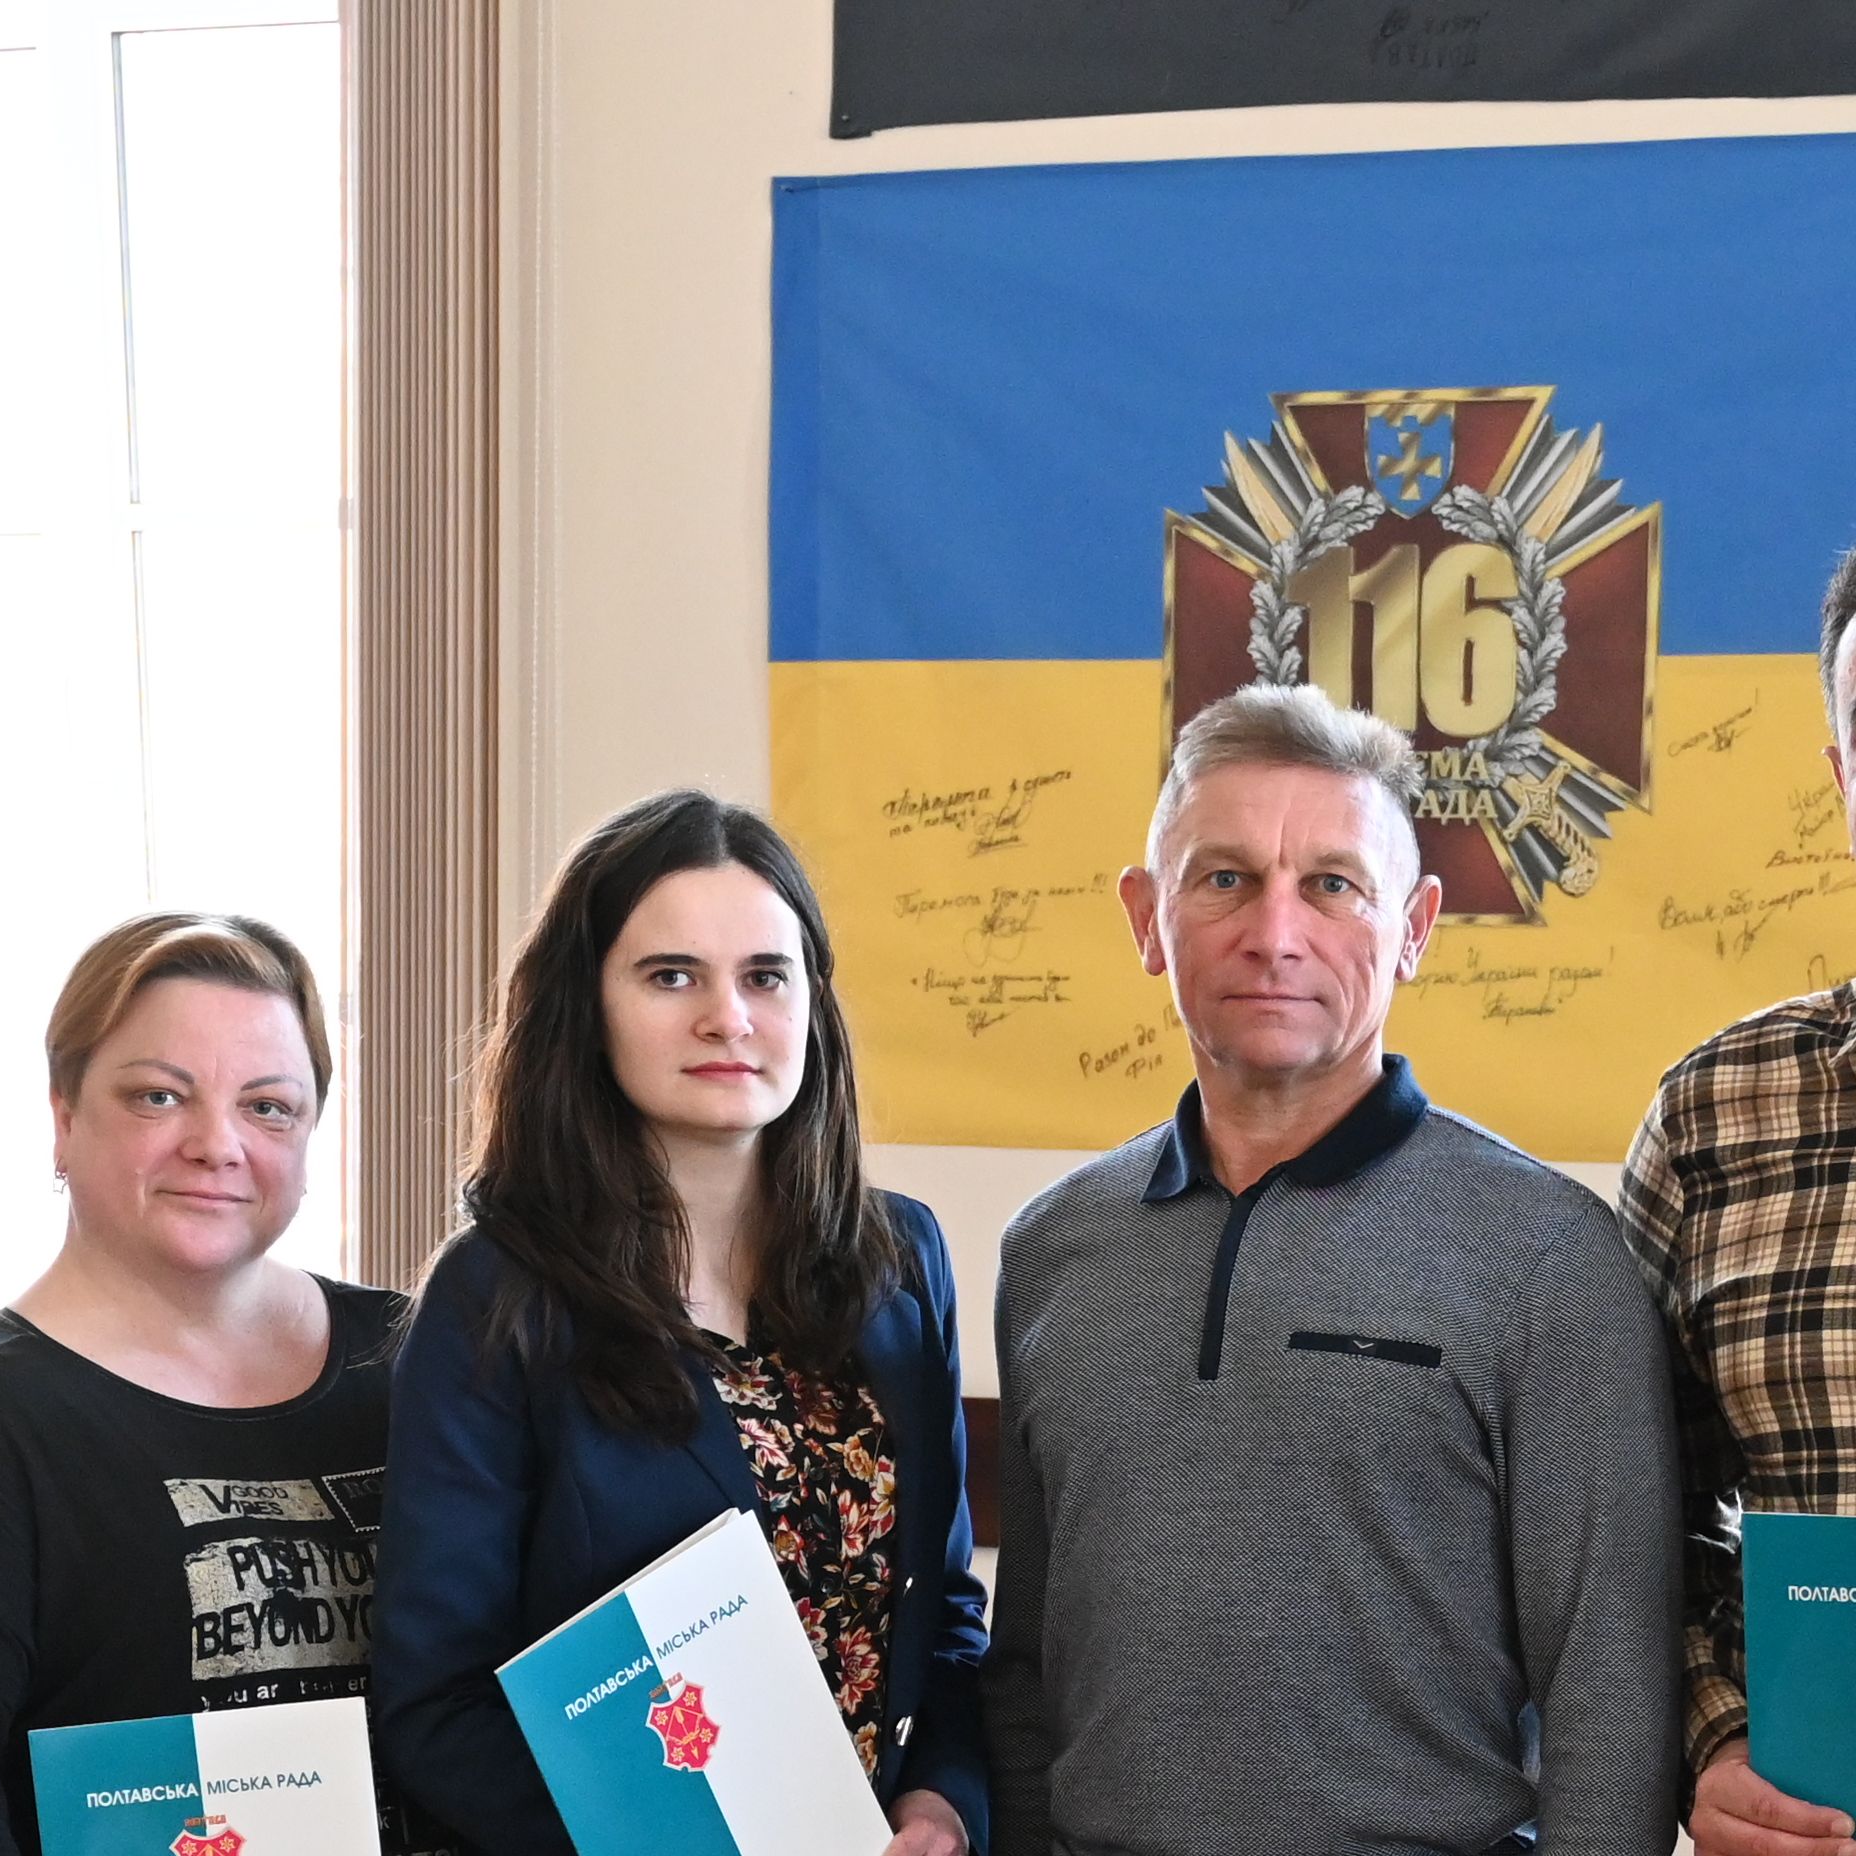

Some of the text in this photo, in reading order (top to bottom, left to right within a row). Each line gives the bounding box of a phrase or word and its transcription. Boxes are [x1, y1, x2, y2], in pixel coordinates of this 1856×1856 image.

[1286, 543, 1519, 738] 116
[564, 1655, 654, 1721] ПОЛТАВСЬКА
[655, 1618, 710, 1660] МІСЬКА
[709, 1594, 749, 1625] РАДА
[86, 1770, 323, 1808] ПОЛТАВСЬКА МІСЬКА РАДА
